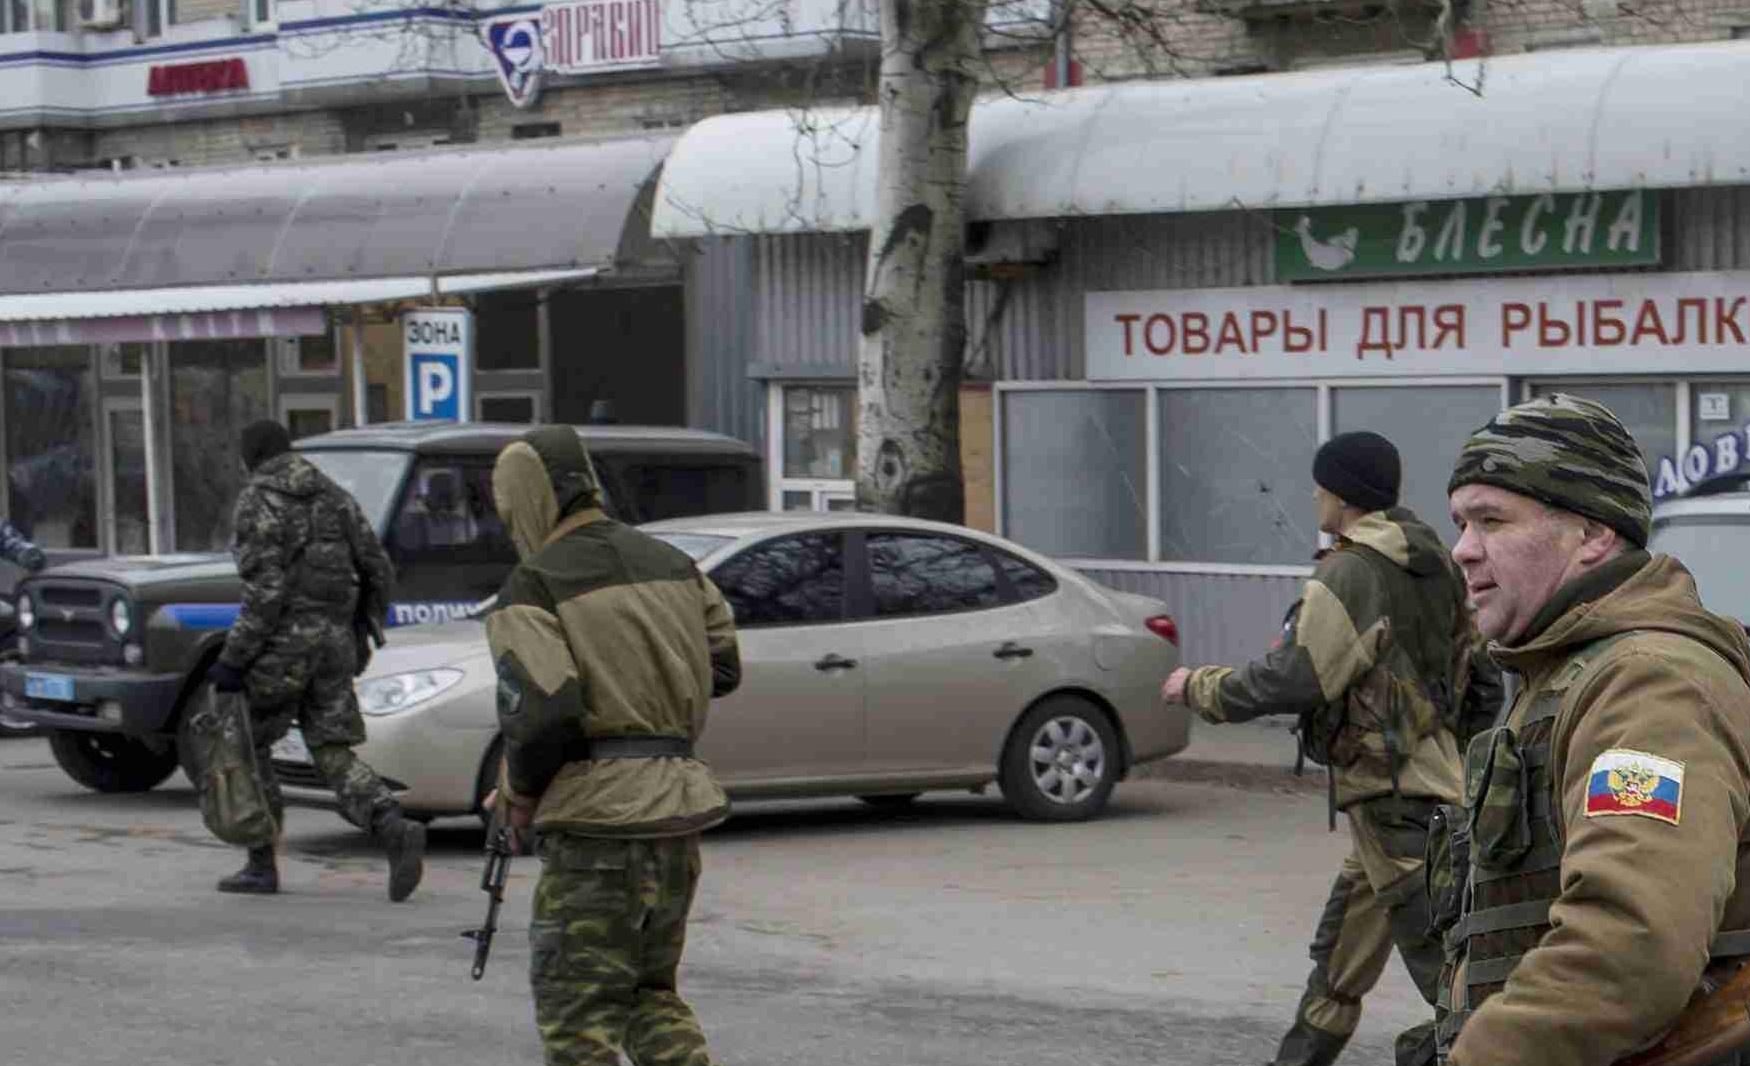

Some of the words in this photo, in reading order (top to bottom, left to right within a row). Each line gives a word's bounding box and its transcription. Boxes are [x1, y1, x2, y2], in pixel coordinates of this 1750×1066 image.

[1397, 188, 1644, 262] БЛЕСНА
[407, 321, 461, 344] ЗОНА
[1113, 307, 1330, 356] ТОВАРЫ
[1356, 303, 1467, 361] ДЛЯ
